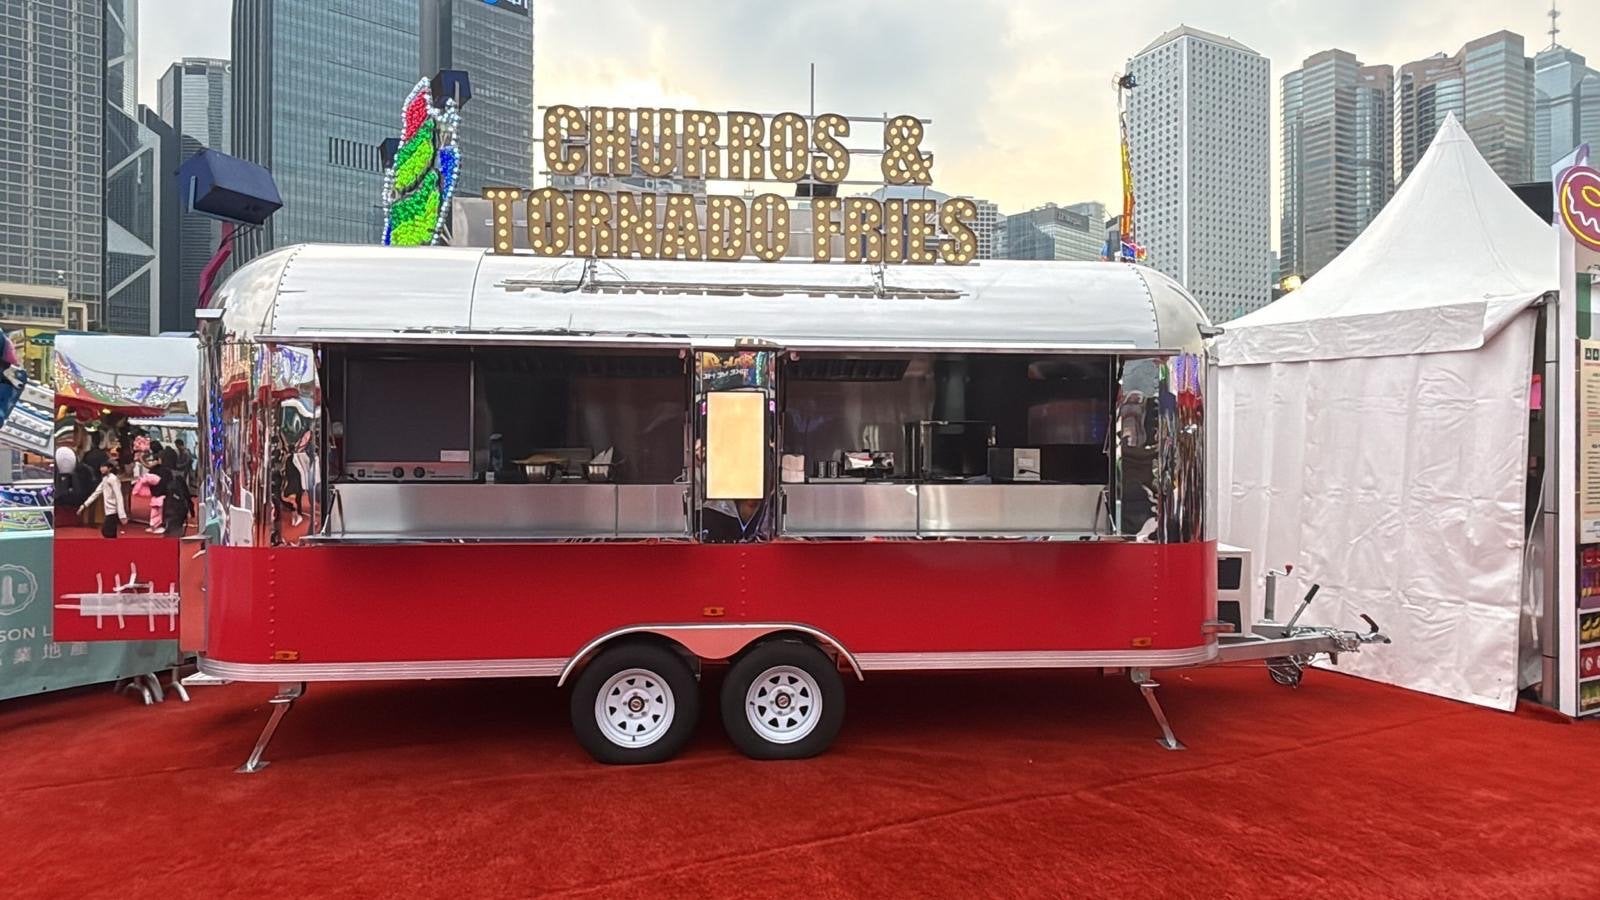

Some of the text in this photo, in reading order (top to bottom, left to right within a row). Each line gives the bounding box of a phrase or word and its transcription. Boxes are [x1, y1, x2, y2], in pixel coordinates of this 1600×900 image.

[542, 104, 933, 184] CHURROS &
[482, 187, 978, 265] TORNADO FRIES
